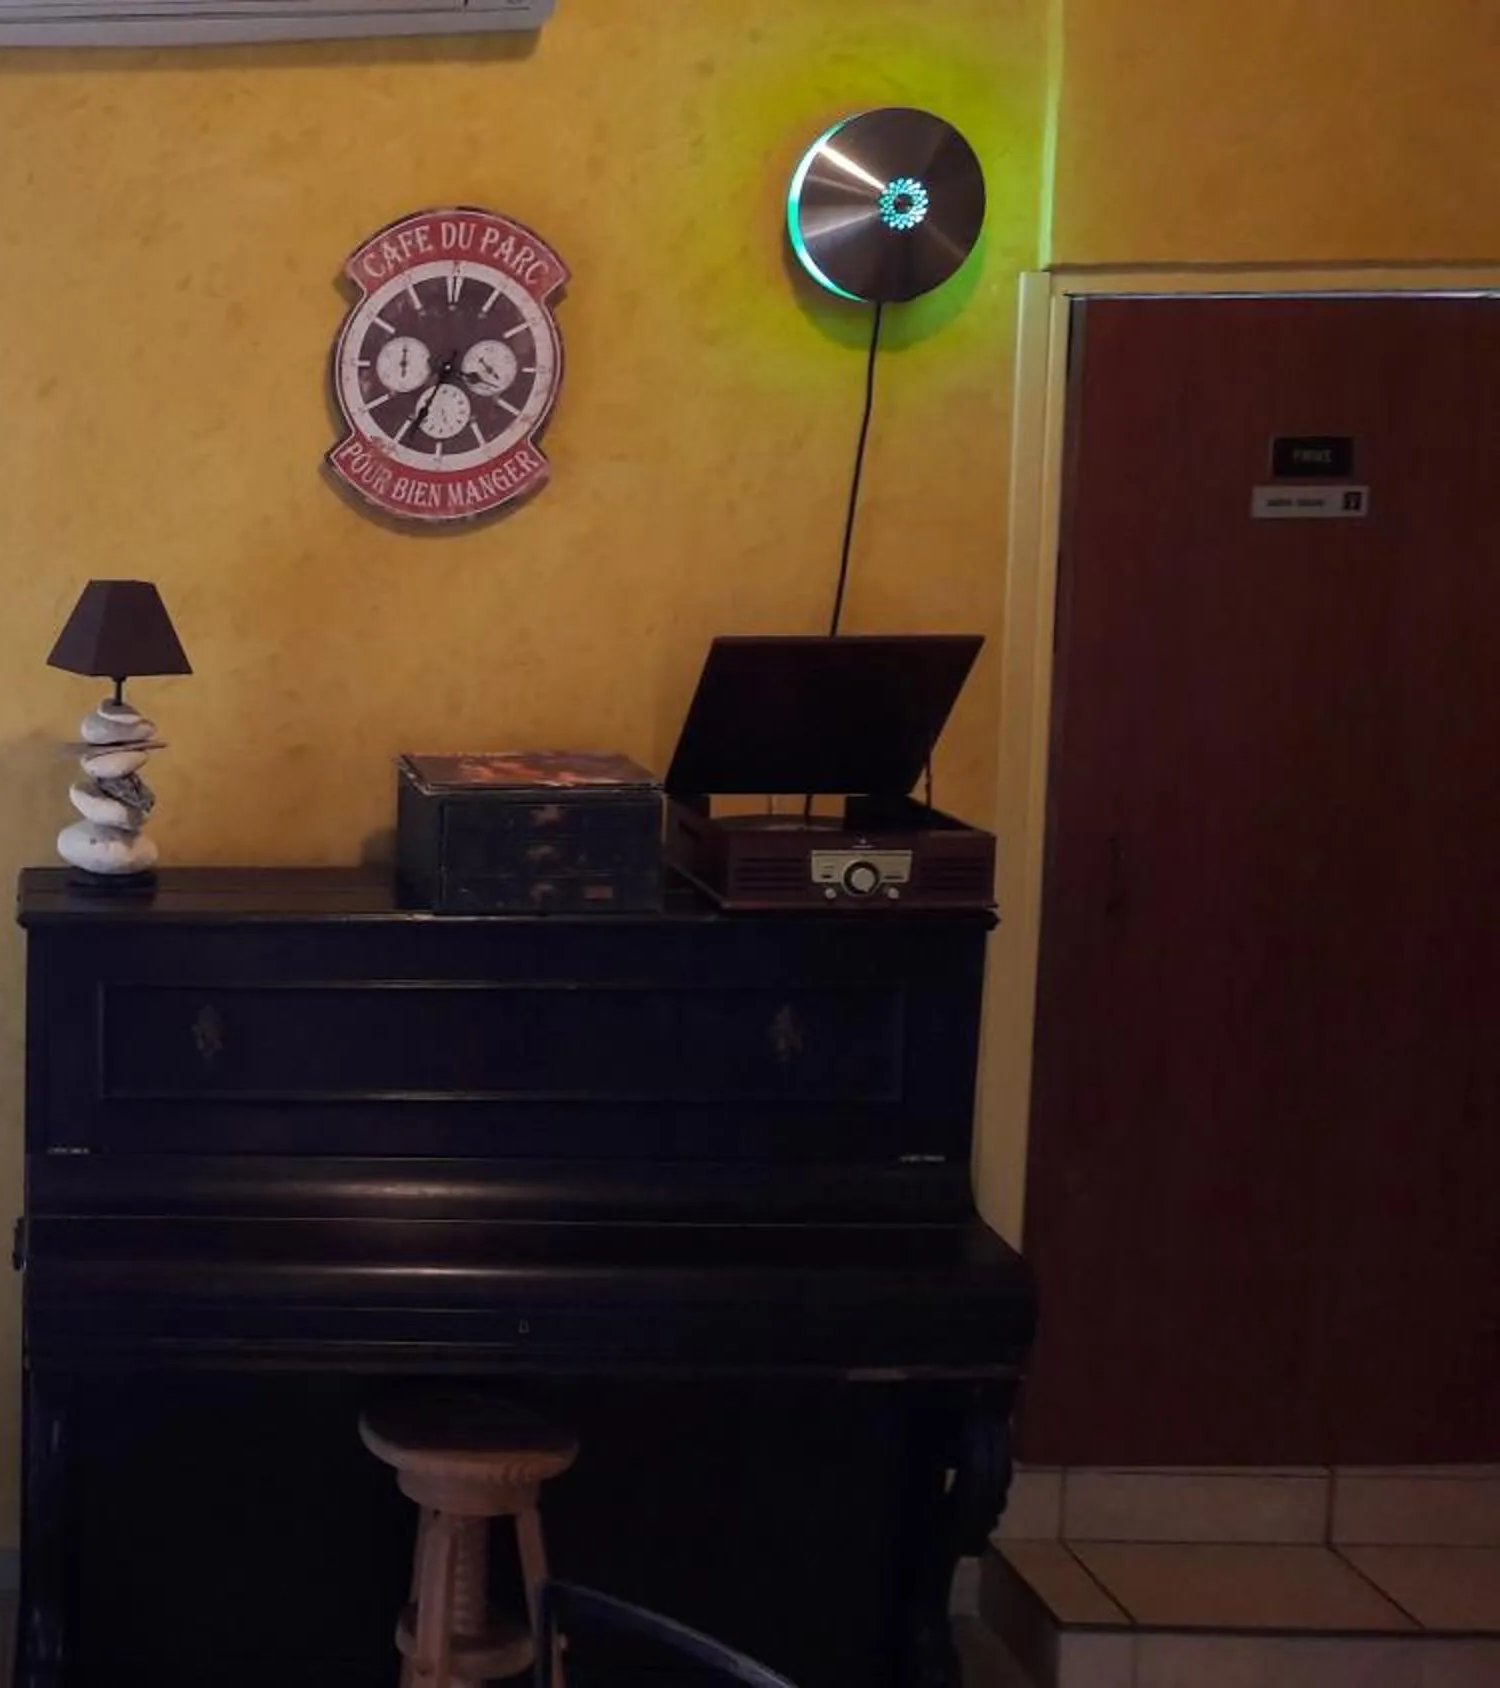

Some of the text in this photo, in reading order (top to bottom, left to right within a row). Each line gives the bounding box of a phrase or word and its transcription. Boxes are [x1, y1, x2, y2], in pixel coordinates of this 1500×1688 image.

[363, 221, 549, 284] CAFE DU PARC
[342, 442, 540, 508] POUR BIEN MANGER
